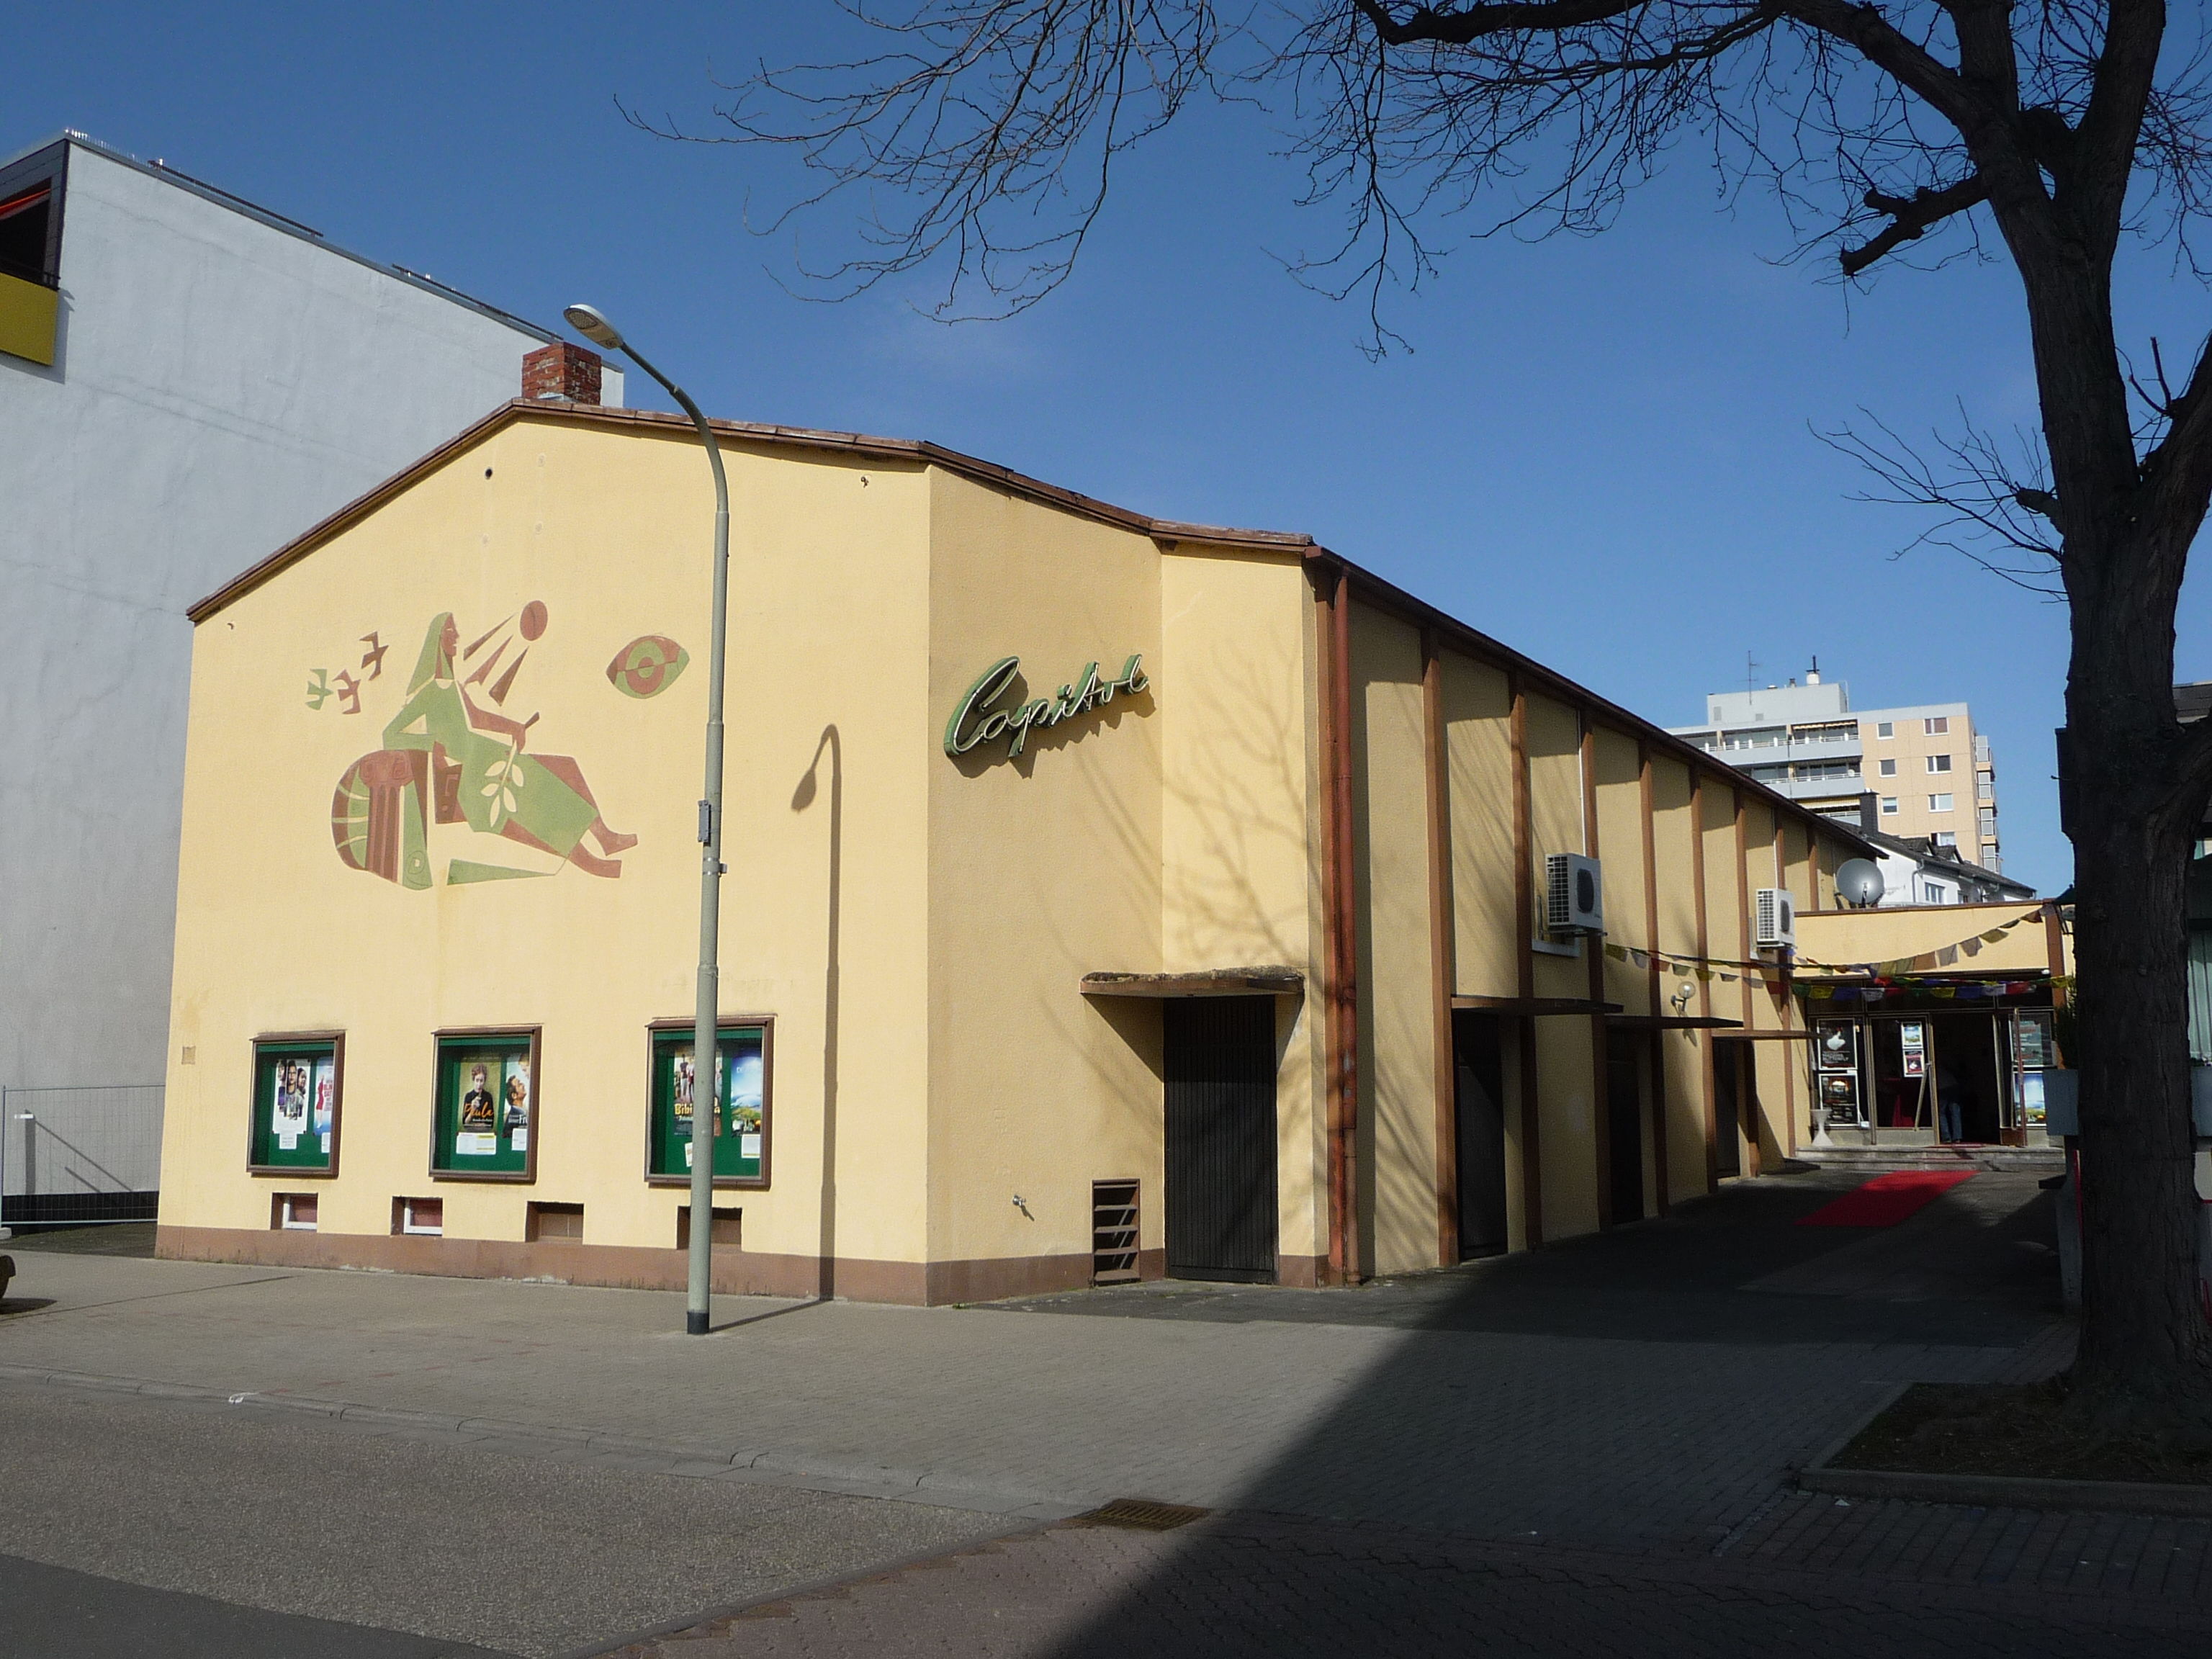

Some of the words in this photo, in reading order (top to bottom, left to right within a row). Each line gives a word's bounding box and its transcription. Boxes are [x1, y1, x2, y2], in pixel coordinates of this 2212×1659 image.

[944, 654, 1149, 757] Capitol
[464, 1101, 494, 1118] Paula
[674, 1102, 693, 1115] Bibi
